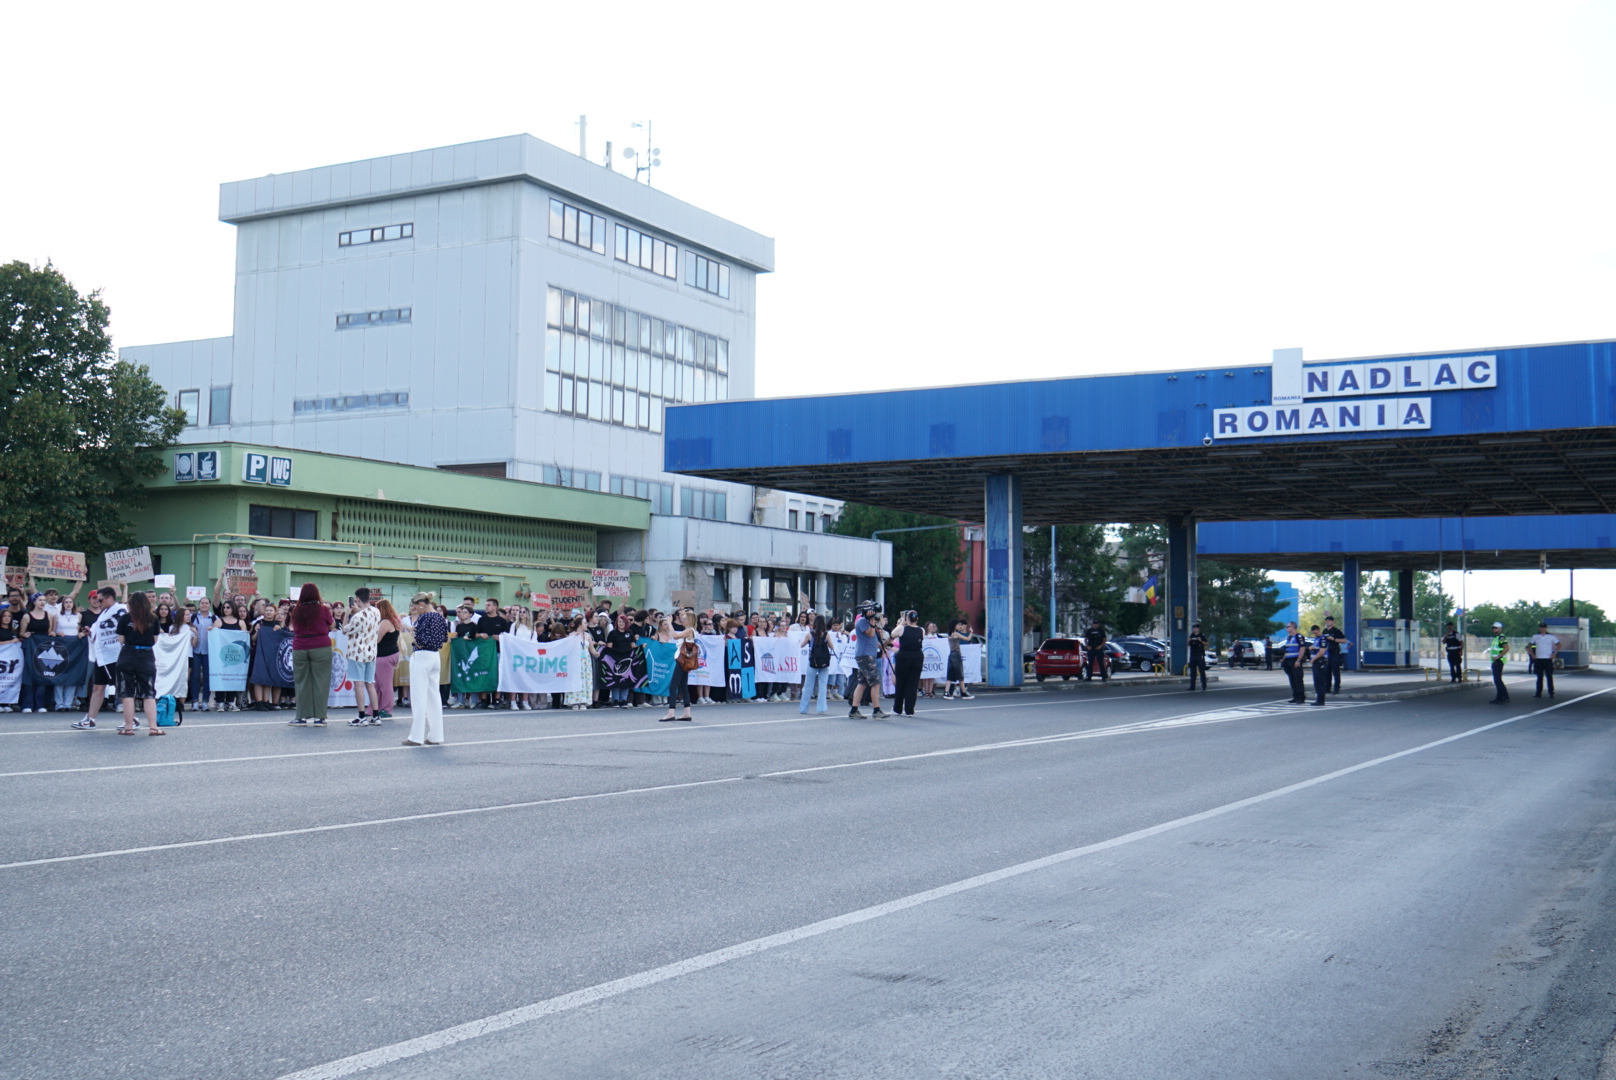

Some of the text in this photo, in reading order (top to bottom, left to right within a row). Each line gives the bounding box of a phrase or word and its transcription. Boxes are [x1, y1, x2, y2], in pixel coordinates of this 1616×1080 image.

[1307, 361, 1491, 393] NADLAC
[1218, 402, 1426, 434] ROMANIA
[250, 455, 265, 476] P
[273, 458, 290, 480] WC
[55, 554, 75, 563] CFR
[549, 579, 589, 589] GUVERNUL
[559, 589, 577, 597] TACE
[224, 654, 241, 662] FSC
[512, 654, 568, 674] PRIME
